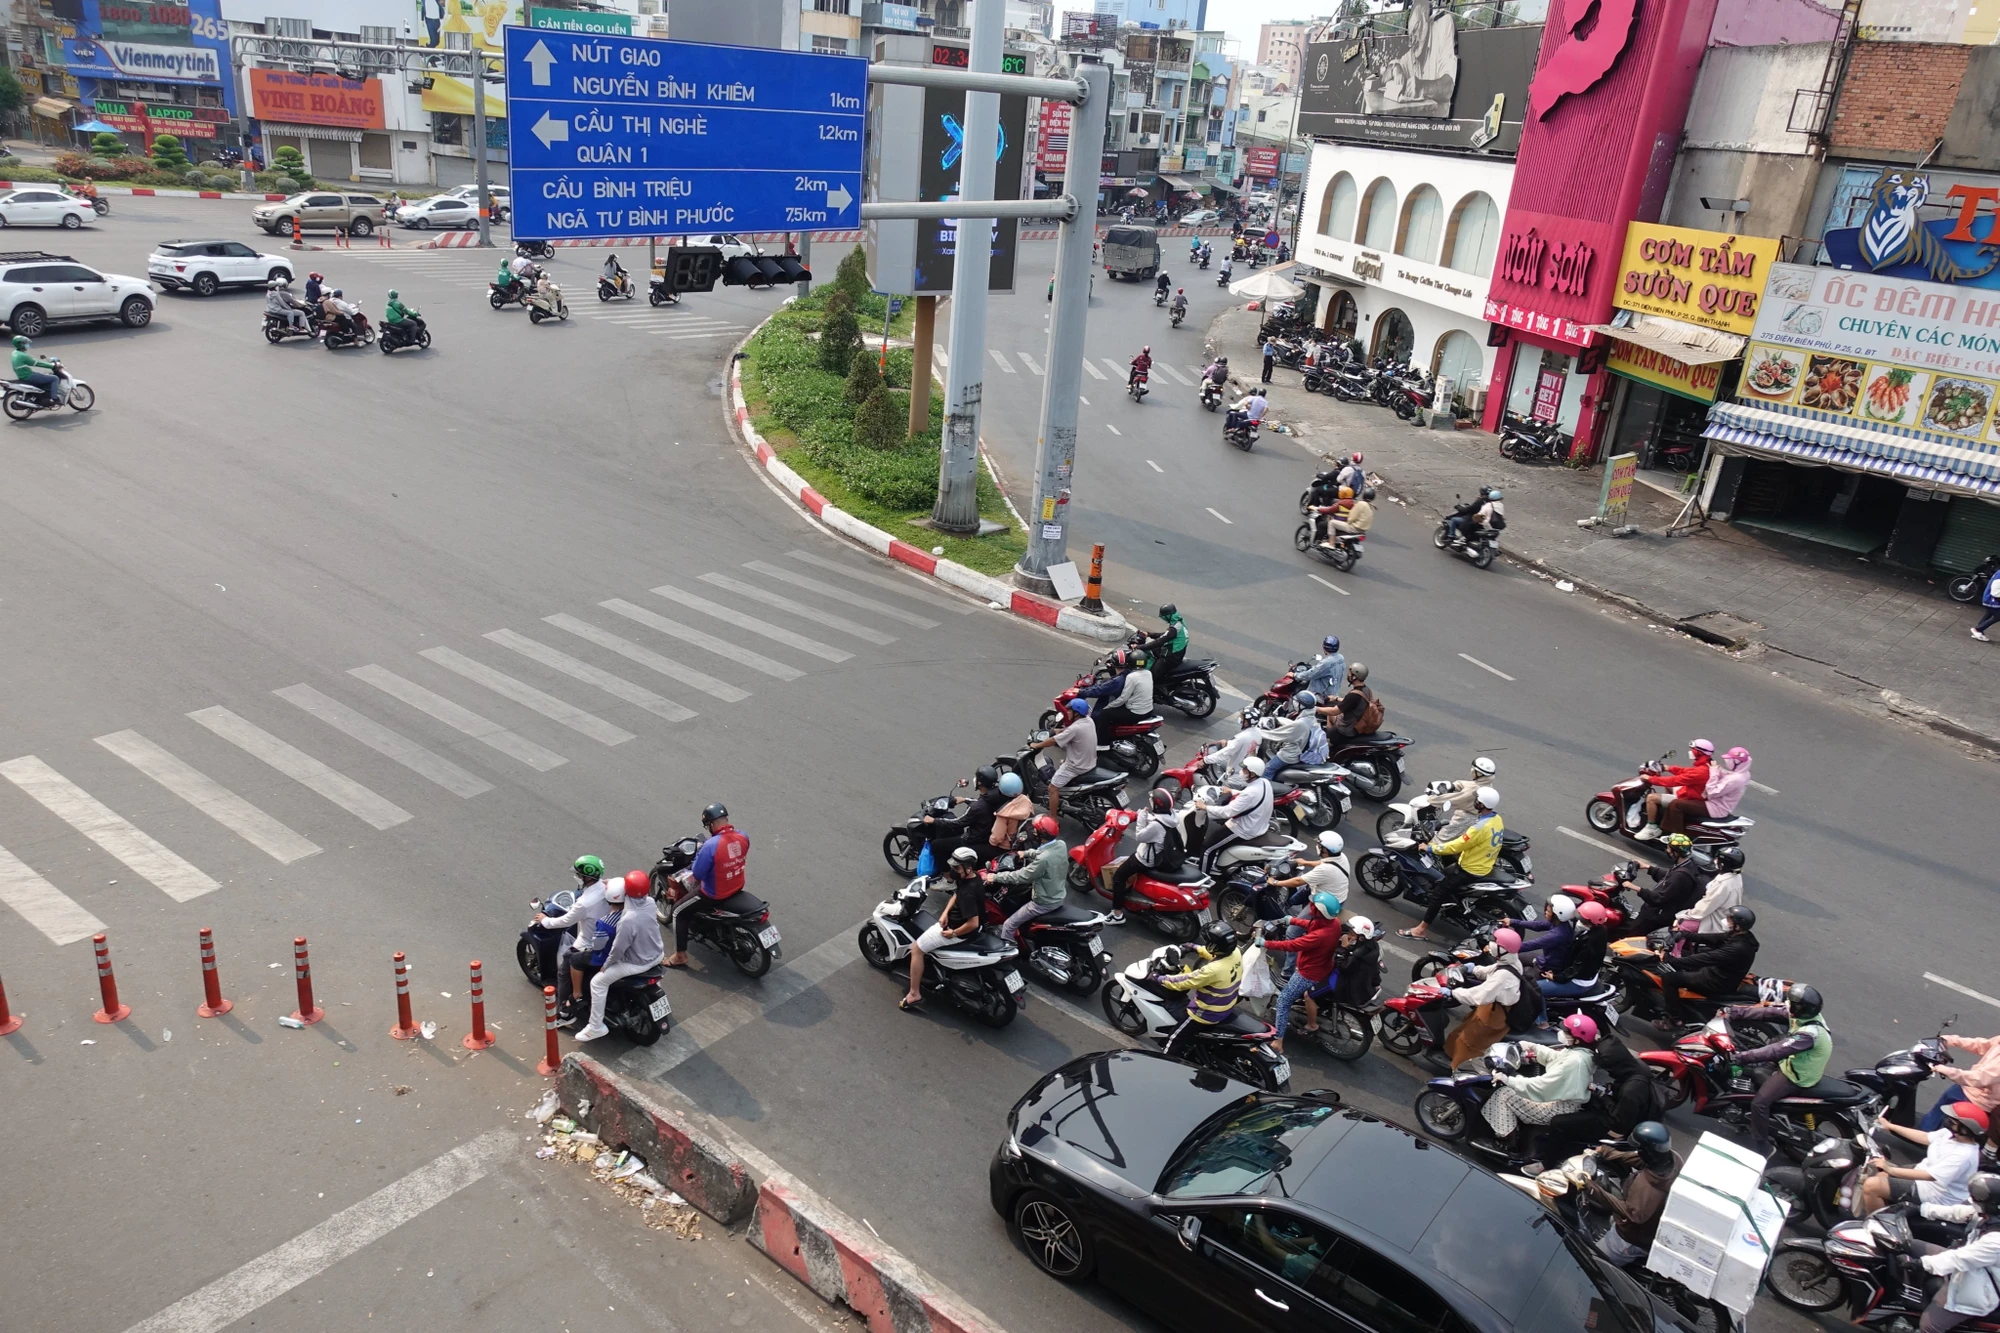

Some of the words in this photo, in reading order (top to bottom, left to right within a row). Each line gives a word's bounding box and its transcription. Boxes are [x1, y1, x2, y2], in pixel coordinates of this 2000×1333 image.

[191, 13, 229, 41] 265
[538, 17, 561, 30] CẦN
[562, 19, 583, 31] TIỀN
[72, 49, 96, 58] VIỆN
[572, 39, 612, 64] NÚT
[620, 47, 661, 67] GIAO
[310, 92, 376, 116] HOÀNG
[573, 72, 649, 97] NGUYỄN
[658, 75, 696, 99] BỈNH
[707, 81, 755, 103] KHIÊM
[830, 92, 860, 109] 1km
[95, 102, 128, 115] MUA
[148, 107, 193, 120] LAPTOP
[574, 108, 613, 132] CẦU
[622, 116, 651, 137] THỊ
[660, 114, 707, 135] NGHÈ
[819, 124, 858, 141] 1,2km
[577, 142, 631, 165] QUẬN
[641, 147, 647, 163] 1
[542, 175, 583, 199] CẦU
[593, 177, 635, 198] BÌNH
[643, 177, 692, 200] TRIỆU
[795, 176, 828, 192] 2km
[547, 208, 589, 229] NGÃ
[596, 209, 623, 228] TƯ
[628, 205, 668, 227] BÌNH
[676, 202, 735, 224] PHƯỚC
[1501, 227, 1546, 288] NÓN
[1544, 240, 1594, 298] SƠN
[1640, 238, 1695, 268] CƠM
[1699, 236, 1756, 278] TẤM
[1623, 268, 1692, 304] SƯỜN
[1697, 284, 1757, 317] QUE
[1823, 274, 1868, 308] ỐC
[1873, 285, 1957, 321] ĐÊM
[1526, 311, 1535, 330] 1
[1552, 318, 1561, 337] 1
[1582, 327, 1591, 345] 1
[1839, 316, 1911, 341] CHUYÊN
[1916, 325, 1954, 347] CÁC
[1957, 333, 2000, 354] MÓN
[1760, 332, 1774, 340] 375
[1865, 349, 1877, 357] BT
[1891, 347, 1922, 361] ĐẶC
[1925, 352, 1963, 368] BIỆT
[1542, 373, 1557, 389] BUY
[1558, 378, 1563, 391] 1
[1690, 363, 1719, 390] QUE
[1539, 387, 1553, 402] GET
[1554, 391, 1560, 405] 1
[1536, 402, 1555, 419] FREE
